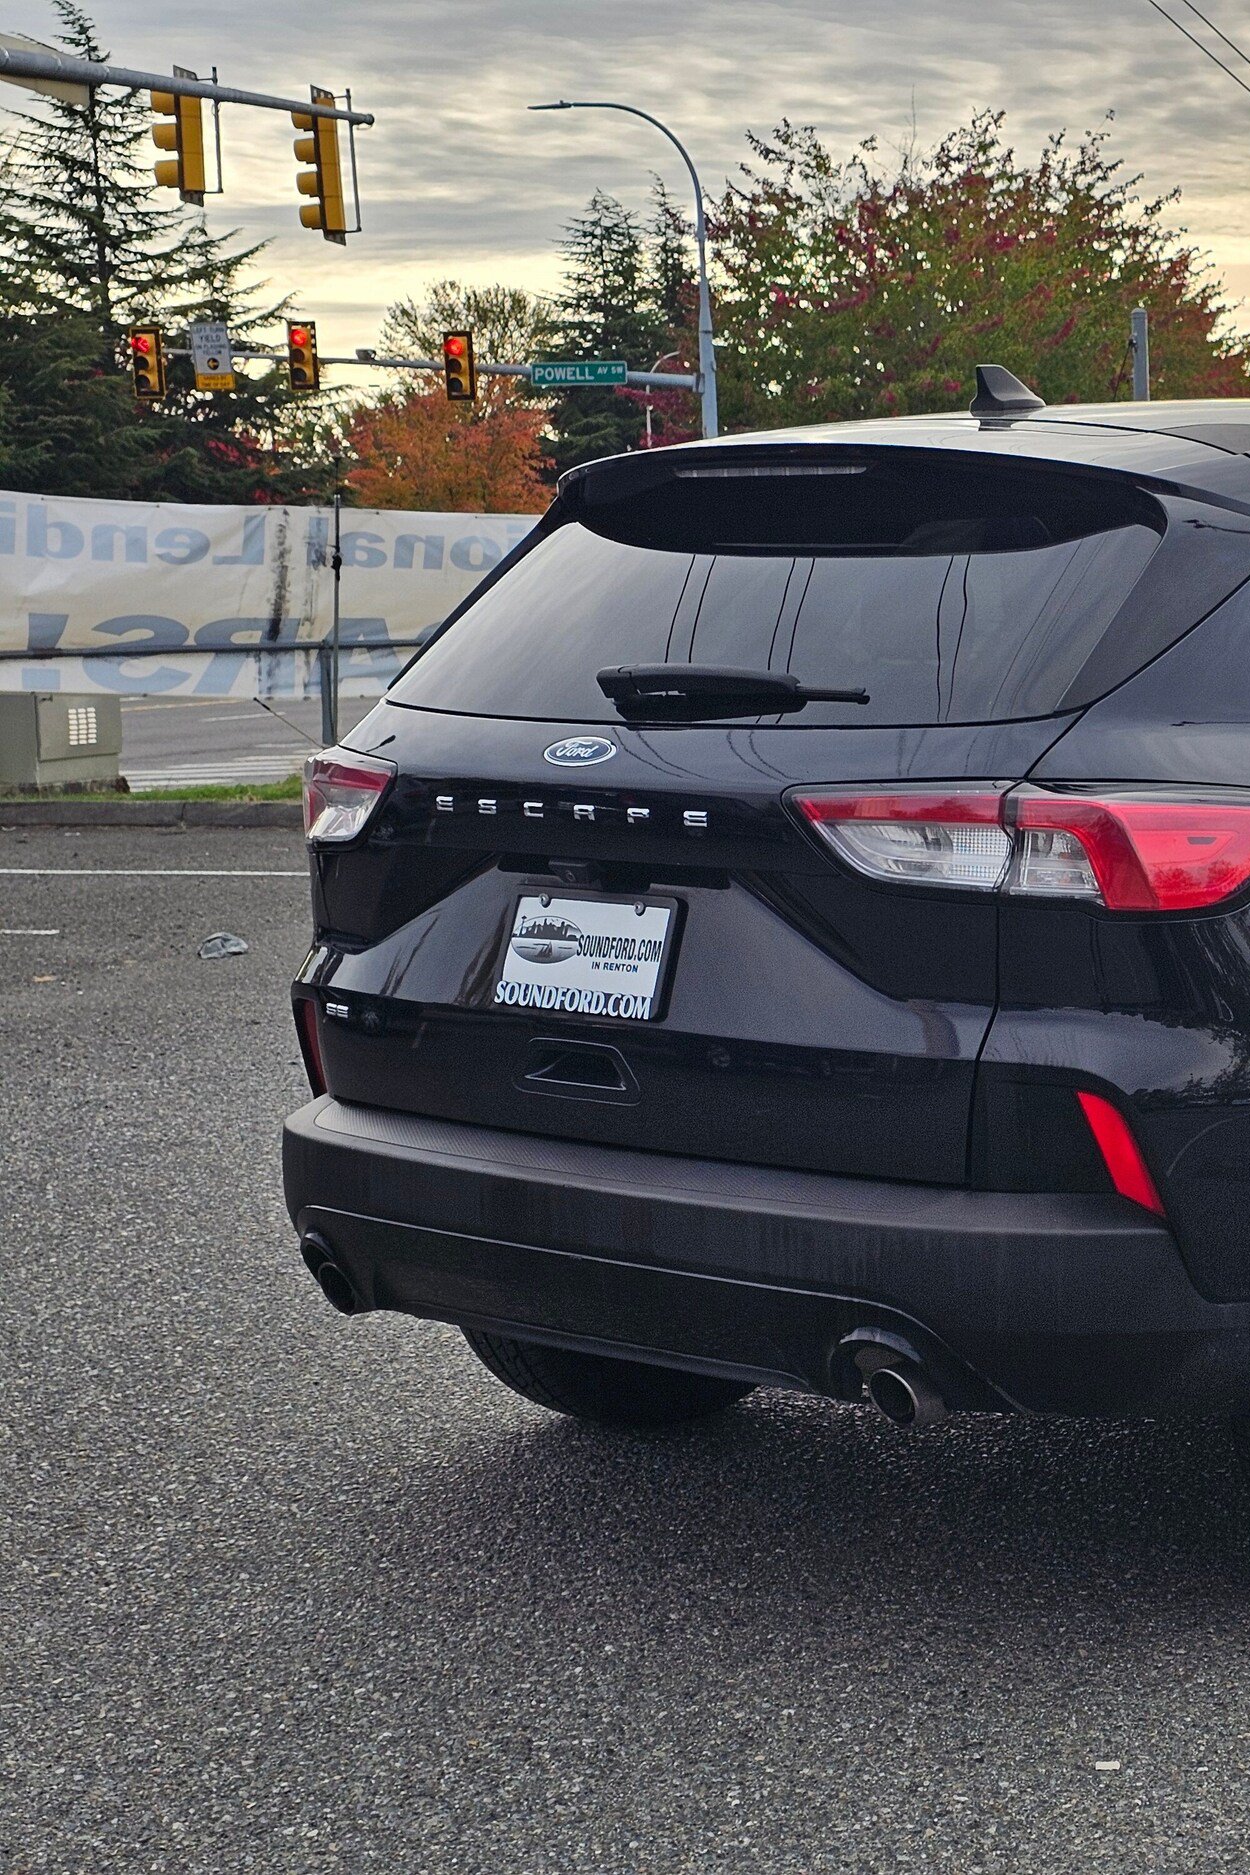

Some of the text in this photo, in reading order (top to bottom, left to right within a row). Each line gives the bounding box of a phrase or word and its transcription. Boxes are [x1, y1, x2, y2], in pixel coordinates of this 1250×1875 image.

[199, 334, 221, 342] YIELD
[534, 366, 624, 381] POWELL AV SW
[554, 739, 600, 759] Ford
[435, 795, 708, 828] ESCAPE
[576, 934, 663, 964] SOUNDFORD.COM
[591, 961, 639, 974] IN RENTON
[494, 980, 651, 1020] SOUNDFORD.COM
[325, 1002, 349, 1019] SE
